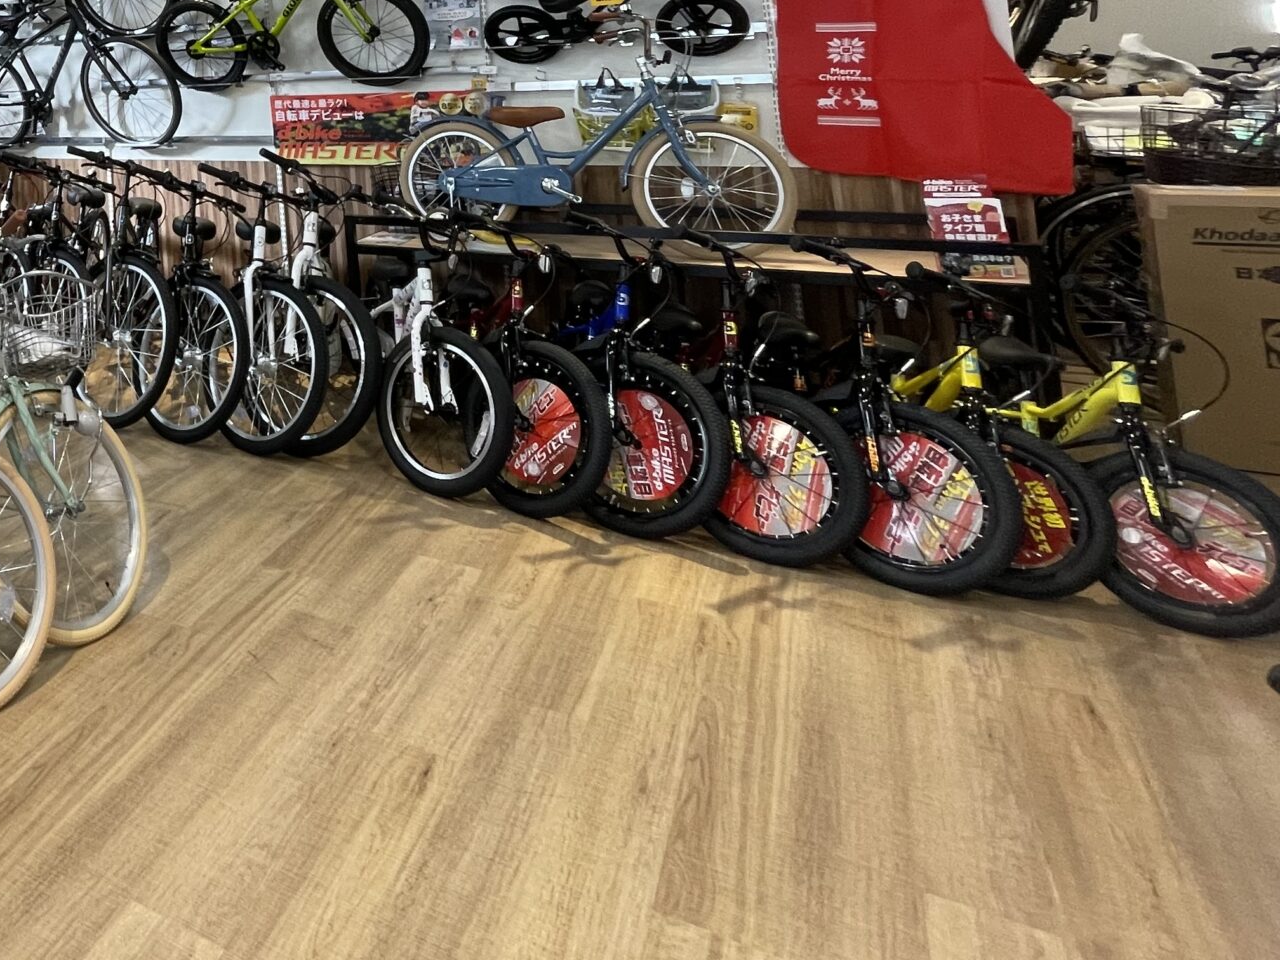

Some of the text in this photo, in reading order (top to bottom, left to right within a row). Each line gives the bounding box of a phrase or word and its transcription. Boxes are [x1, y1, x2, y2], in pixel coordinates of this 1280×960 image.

[830, 67, 861, 76] Merry
[818, 74, 872, 82] Christmas
[275, 109, 365, 121] 自転車デビューは
[940, 214, 982, 223] お子さま
